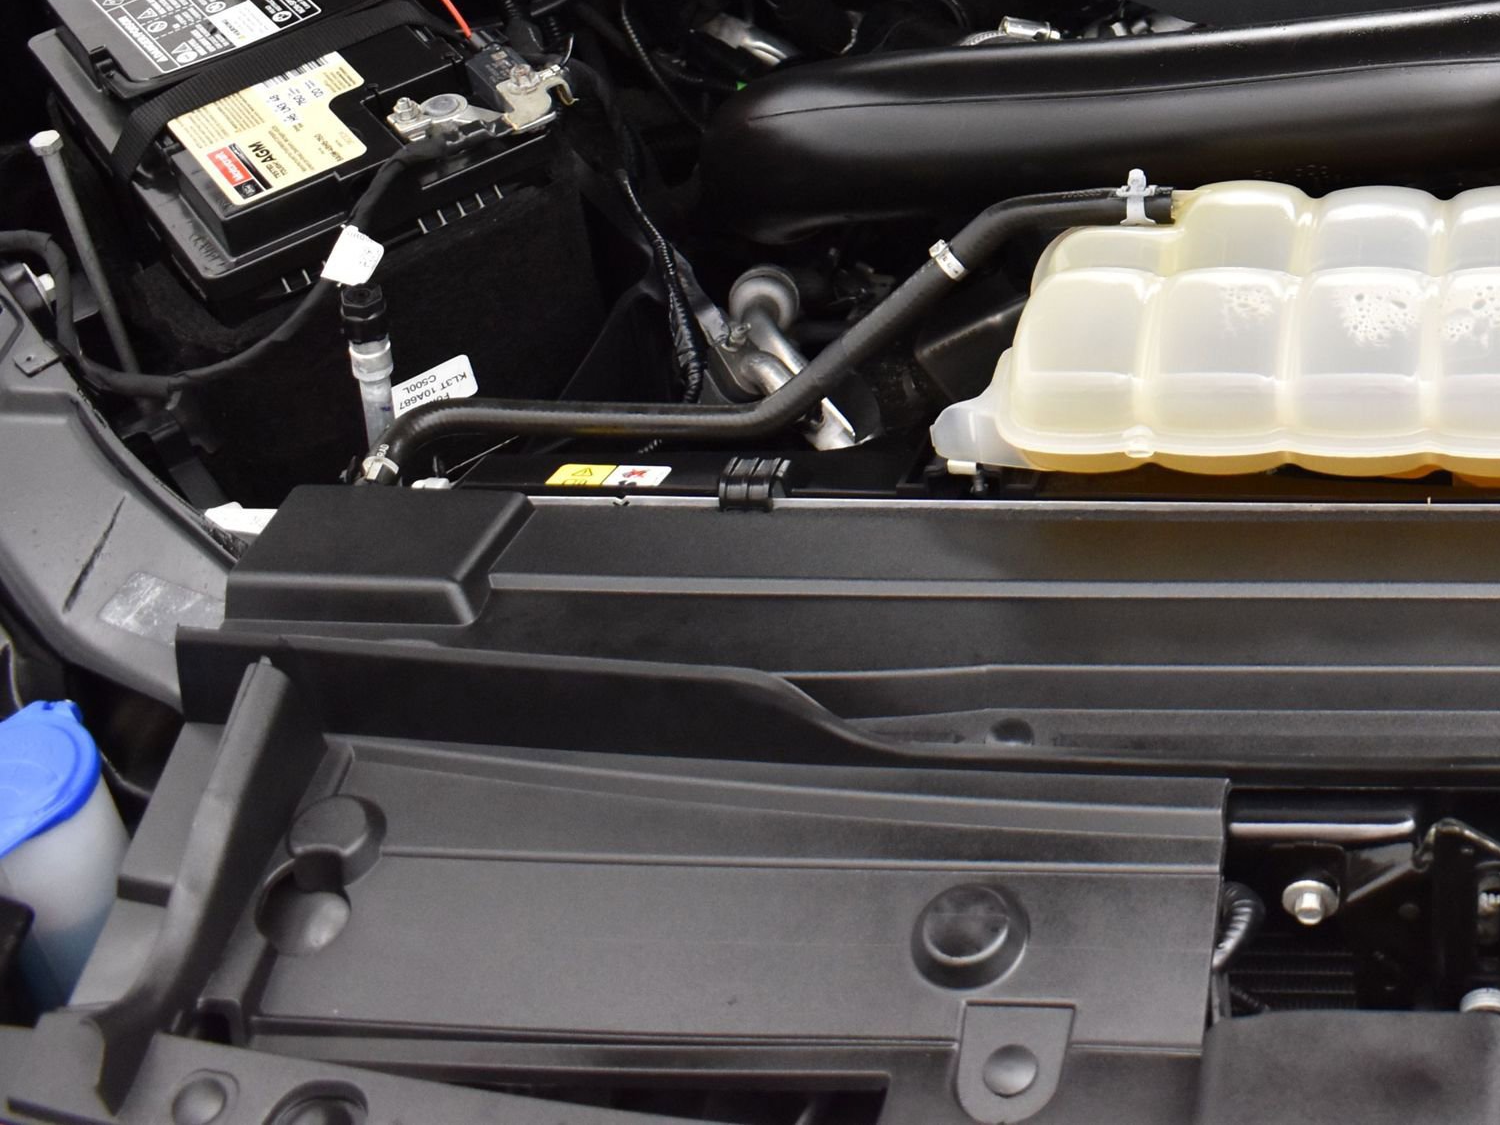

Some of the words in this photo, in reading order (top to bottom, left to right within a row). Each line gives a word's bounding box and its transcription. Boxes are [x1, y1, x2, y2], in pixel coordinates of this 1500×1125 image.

[247, 140, 276, 164] AGM
[212, 151, 246, 181] Motorcraft
[402, 374, 437, 394] C500L
[440, 372, 467, 390] KL3T
[400, 387, 436, 410] 10A687
